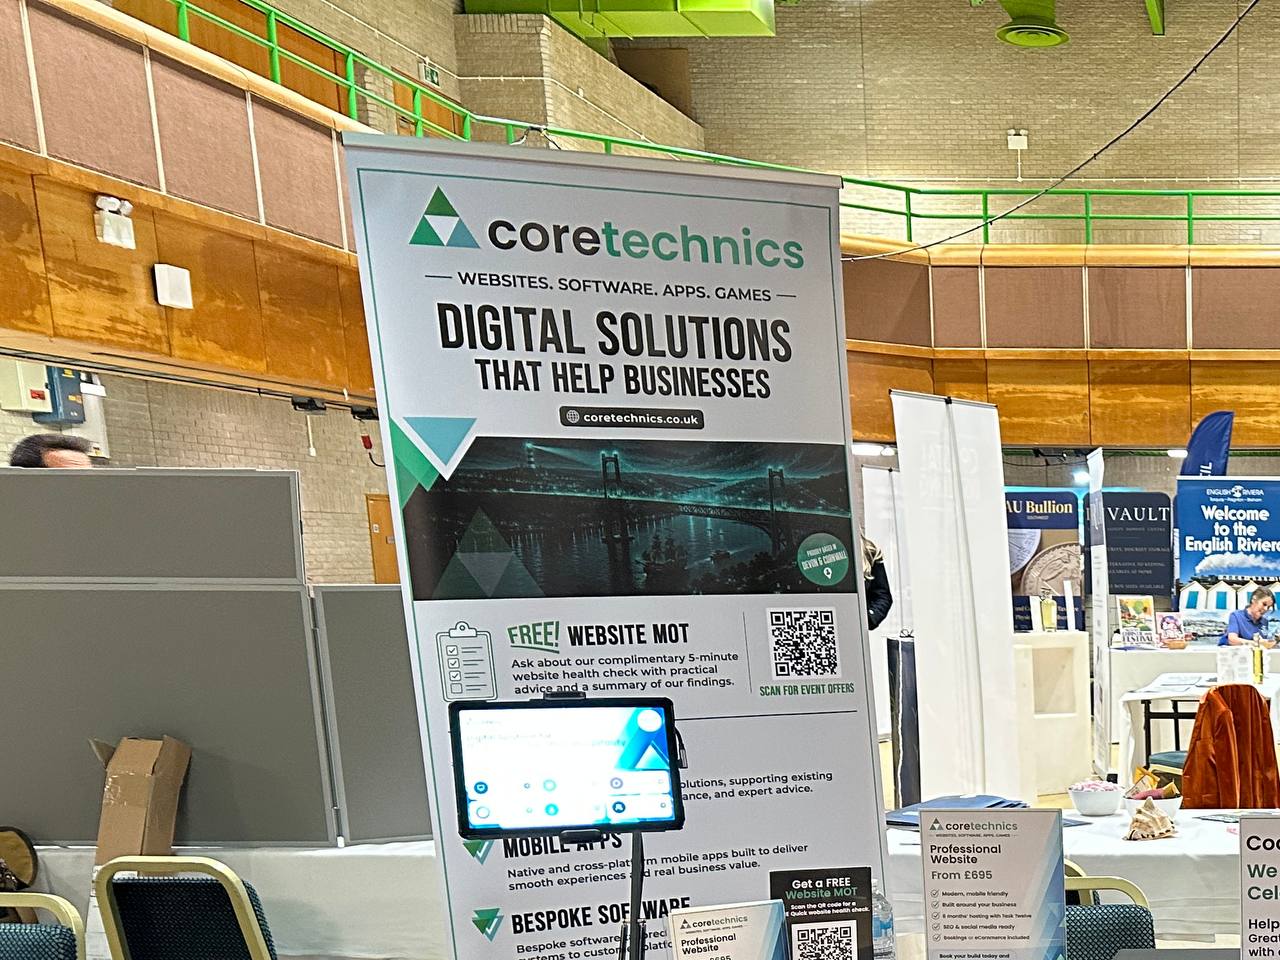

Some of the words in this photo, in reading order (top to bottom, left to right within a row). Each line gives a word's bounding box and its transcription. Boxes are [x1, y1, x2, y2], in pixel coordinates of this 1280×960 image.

[488, 217, 804, 269] coretechnics
[458, 271, 554, 290] WEBSITES.
[558, 277, 658, 296] SOFTWARE.
[663, 284, 710, 299] APPS.
[715, 287, 771, 302] GAMES
[437, 302, 585, 354] DIGITAL
[597, 311, 792, 362] SOLUTIONS
[475, 359, 541, 392] THAT
[553, 363, 615, 395] HELP
[625, 365, 770, 399] BUSINESSES
[583, 411, 698, 425] coretechnics.co.uk
[1026, 500, 1072, 513] Bullion
[1201, 505, 1270, 520] Welcome
[1107, 507, 1170, 521] VAULT
[1214, 522, 1230, 536] to
[1233, 521, 1257, 536] the
[1185, 536, 1233, 555] English
[802, 558, 818, 570] DEVON
[823, 550, 847, 564] CORNWALL
[507, 621, 560, 647] FREE!
[568, 624, 647, 646] WEBSITE
[653, 623, 689, 644] MOT
[512, 659, 534, 668] Ask
[537, 657, 571, 668] about
[575, 657, 594, 666] our
[598, 654, 685, 665] complimentary
[688, 652, 738, 662] 5-minute
[513, 671, 559, 681] website
[563, 669, 599, 680] health
[603, 667, 638, 678] check
[641, 666, 667, 677] with
[670, 665, 718, 676] practical
[514, 684, 552, 694] advice
[557, 683, 579, 692] and
[582, 684, 589, 692] a
[592, 680, 647, 691] summary
[651, 679, 662, 689] of
[665, 679, 684, 688] our
[687, 676, 735, 688] findings.
[759, 685, 781, 696] SCAN
[783, 685, 798, 695] FOR
[801, 684, 825, 695] EVENT
[828, 683, 854, 694] OFFERS
[729, 774, 788, 786] supporting
[792, 771, 833, 781] existing
[714, 789, 735, 798] and
[738, 786, 773, 797] expert
[776, 785, 813, 794] advice.
[946, 822, 1018, 830] coretechnics
[930, 844, 1001, 854] Professional
[508, 867, 545, 878] Native
[549, 864, 570, 874] and
[661, 853, 699, 864] mobile
[702, 851, 728, 861] apps
[731, 848, 756, 858] built
[772, 844, 808, 854] deliver
[931, 855, 978, 863] Website
[509, 879, 553, 891] smooth
[557, 872, 626, 887] experiences
[654, 866, 674, 876] real
[678, 862, 726, 874] business
[729, 860, 760, 870] value.
[932, 871, 960, 879] From
[965, 870, 993, 879] £695
[1247, 864, 1277, 878] We
[792, 880, 812, 889] Get
[815, 880, 823, 888] a
[826, 877, 851, 887] FREE
[785, 889, 831, 900] Website
[834, 887, 858, 896] MOT
[512, 907, 592, 934] BESPOKE
[693, 916, 748, 928] coretechnics
[1249, 918, 1280, 932] Help
[517, 941, 566, 954] Bespoke
[570, 935, 621, 947] software
[681, 933, 736, 946] Professional
[682, 944, 719, 955] Website
[1249, 947, 1274, 957] with
